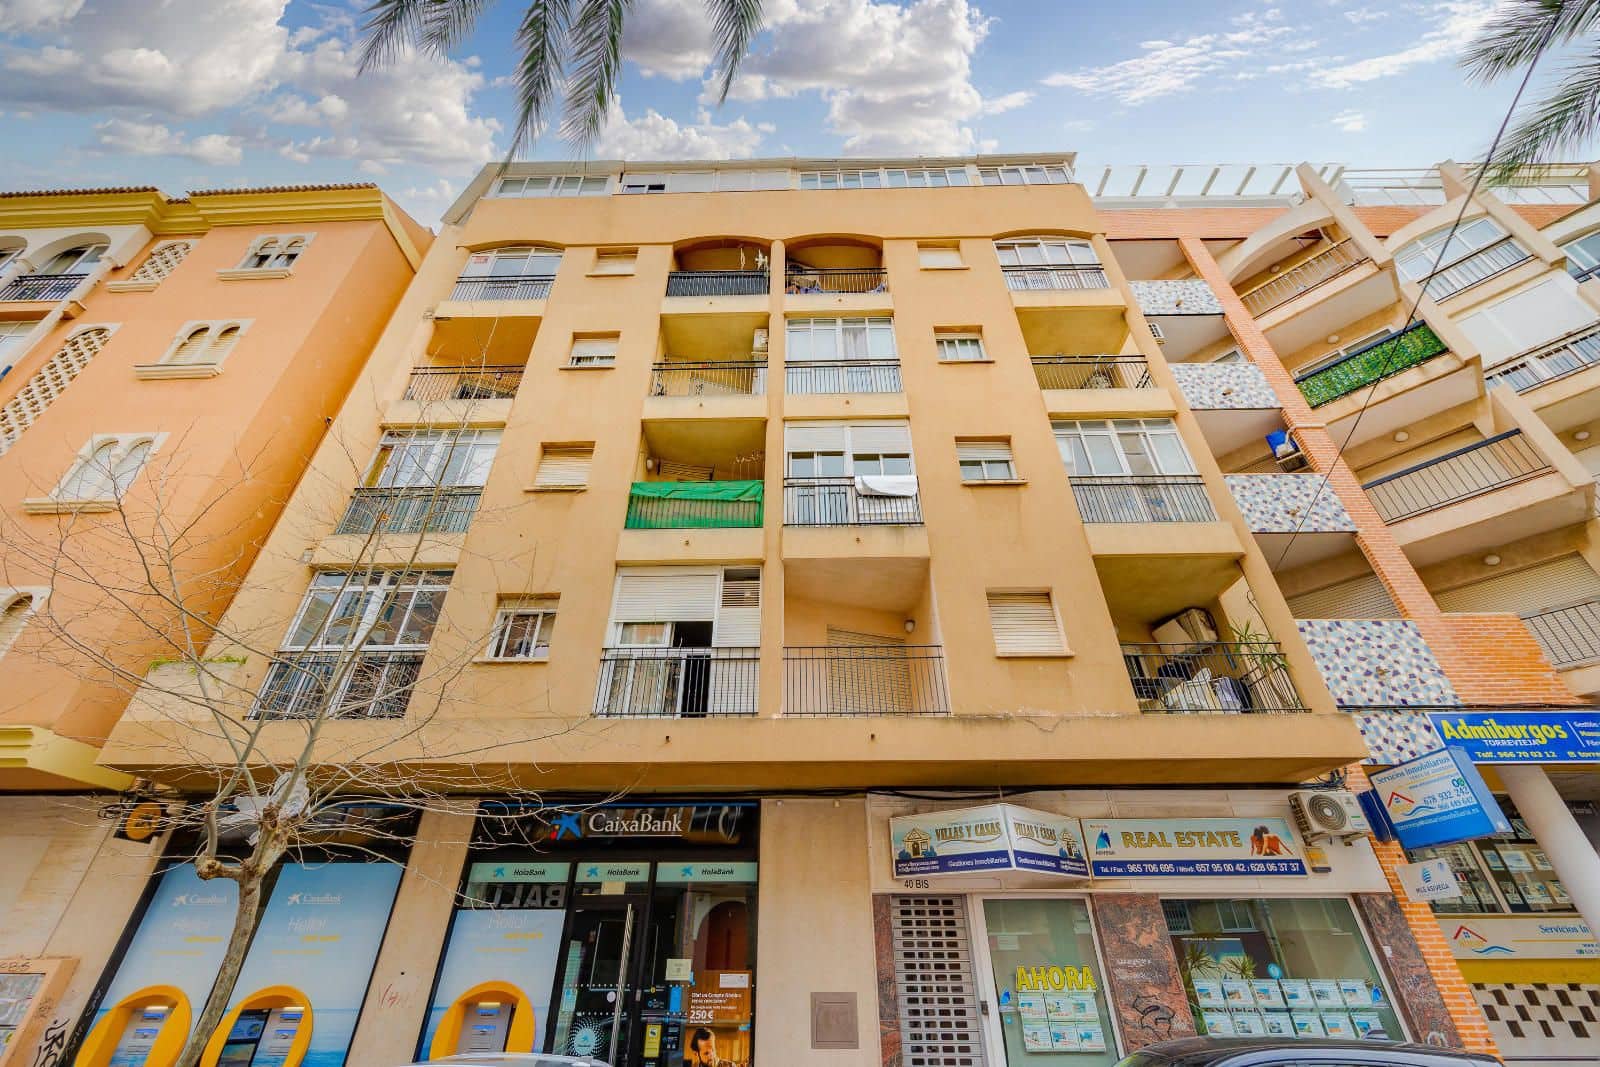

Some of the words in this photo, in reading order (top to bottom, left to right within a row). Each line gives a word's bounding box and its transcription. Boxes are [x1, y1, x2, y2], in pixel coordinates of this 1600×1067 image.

[1441, 719, 1568, 745] Admiburgos
[588, 813, 682, 833] CaixaBank
[935, 826, 965, 842] VILLAS
[966, 827, 972, 838] Y
[974, 822, 1003, 837] CASAS
[1014, 822, 1034, 838] VILLAS
[1034, 825, 1039, 838] Y
[1121, 831, 1173, 849] REAL
[1174, 830, 1243, 849] ESTATE
[513, 868, 546, 876] HolaBank
[607, 868, 640, 876] HolaBank
[701, 868, 734, 876] HolaBank
[1127, 863, 1142, 873] 965
[1143, 863, 1159, 873] 706
[1160, 863, 1175, 873] 695
[1196, 863, 1209, 872] 657
[1211, 863, 1222, 872] 95
[1223, 863, 1234, 872] 00
[1235, 863, 1246, 872] 42
[1250, 863, 1265, 872] 628
[1266, 863, 1277, 872] 06
[1278, 863, 1288, 872] 37
[1289, 862, 1299, 872] 37
[904, 879, 913, 889] 40
[915, 879, 930, 889] BIS
[1539, 925, 1578, 935] Servicios
[1016, 965, 1098, 992] AHORA
[689, 1010, 707, 1020] 250
[708, 1010, 714, 1020] €
